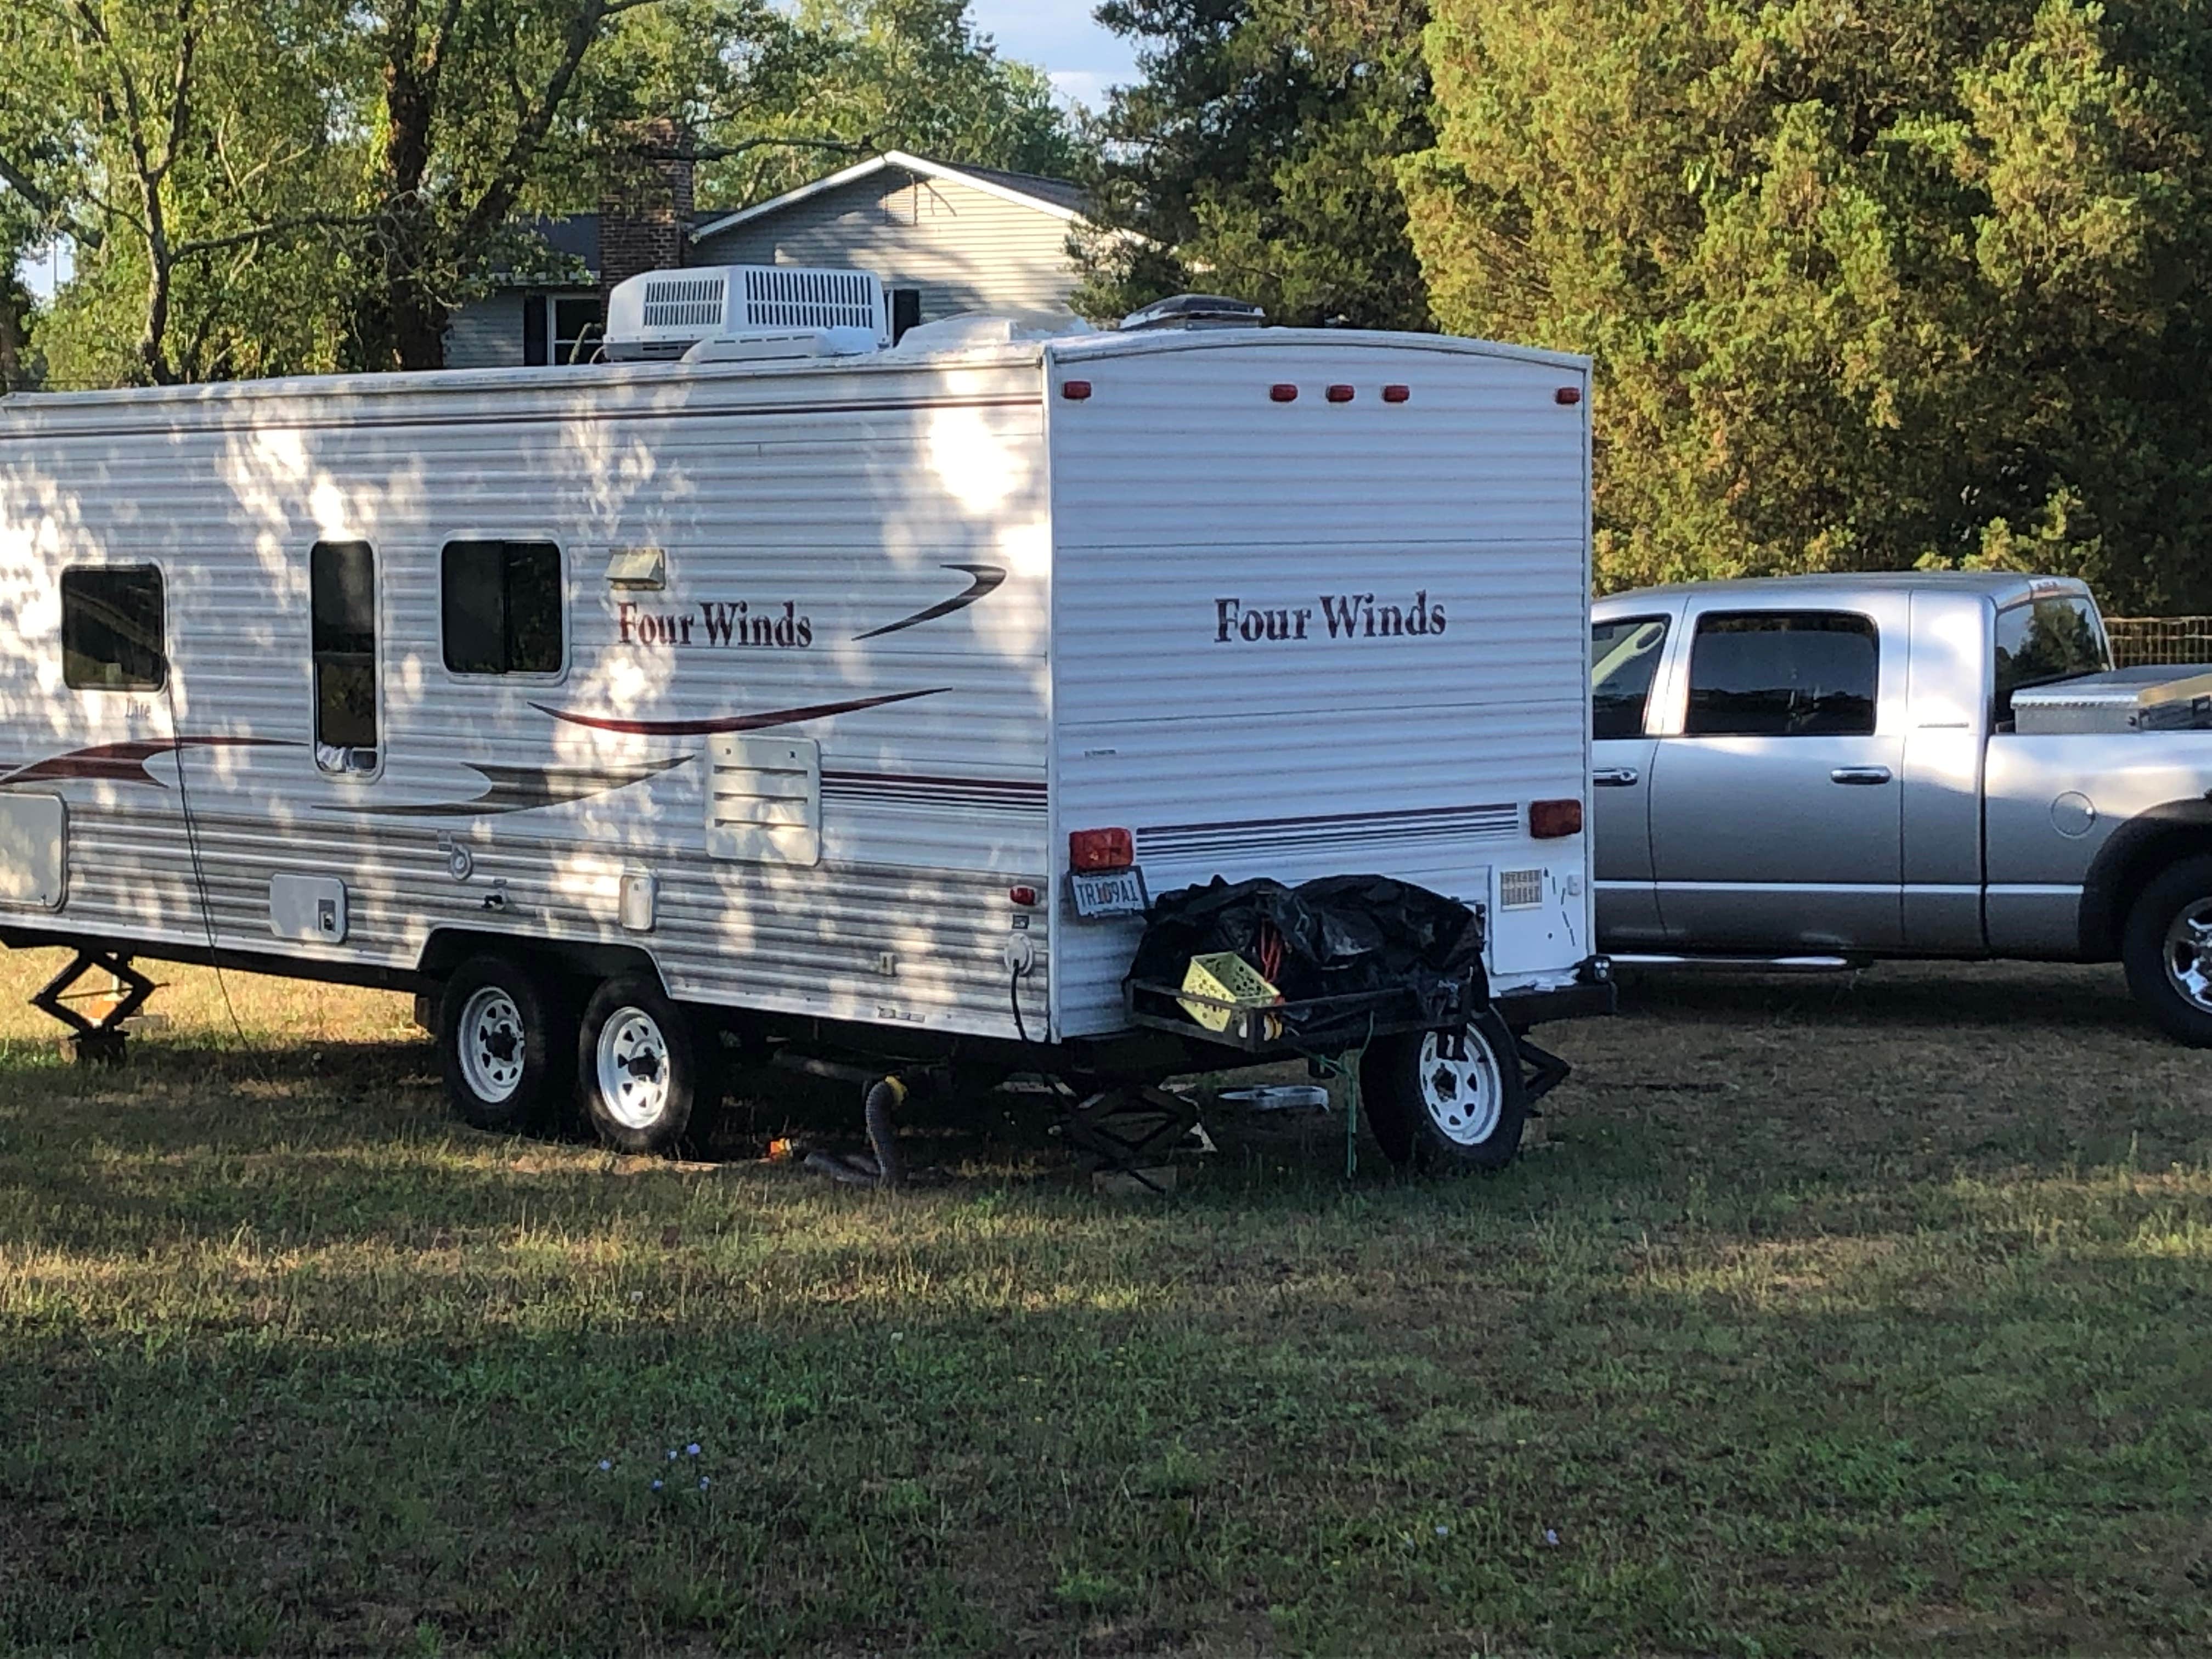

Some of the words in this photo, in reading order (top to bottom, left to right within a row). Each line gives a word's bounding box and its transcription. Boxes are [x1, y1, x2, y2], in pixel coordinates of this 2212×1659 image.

[618, 600, 694, 646] Four
[699, 599, 812, 648] Winds
[1214, 598, 1312, 643] Four
[1319, 589, 1446, 639] Winds
